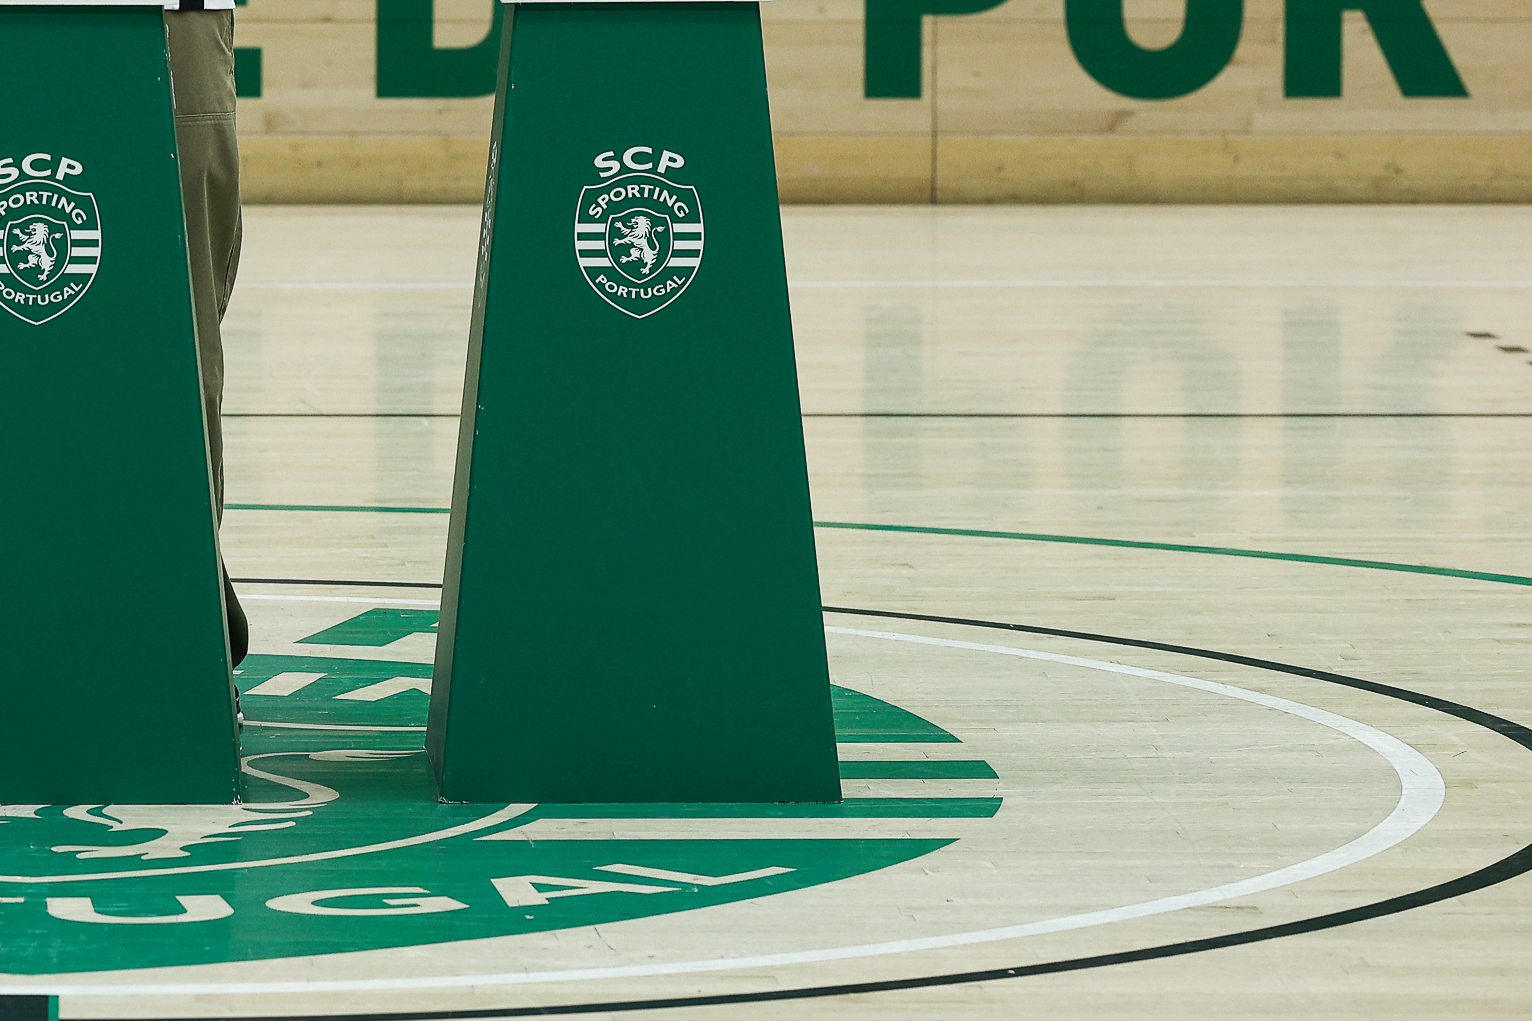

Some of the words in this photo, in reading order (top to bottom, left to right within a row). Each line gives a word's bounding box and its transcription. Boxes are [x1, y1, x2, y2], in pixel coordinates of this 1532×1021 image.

[593, 145, 685, 178] SCP
[588, 184, 689, 219] SPORTING
[595, 273, 686, 299] PORTUGAL
